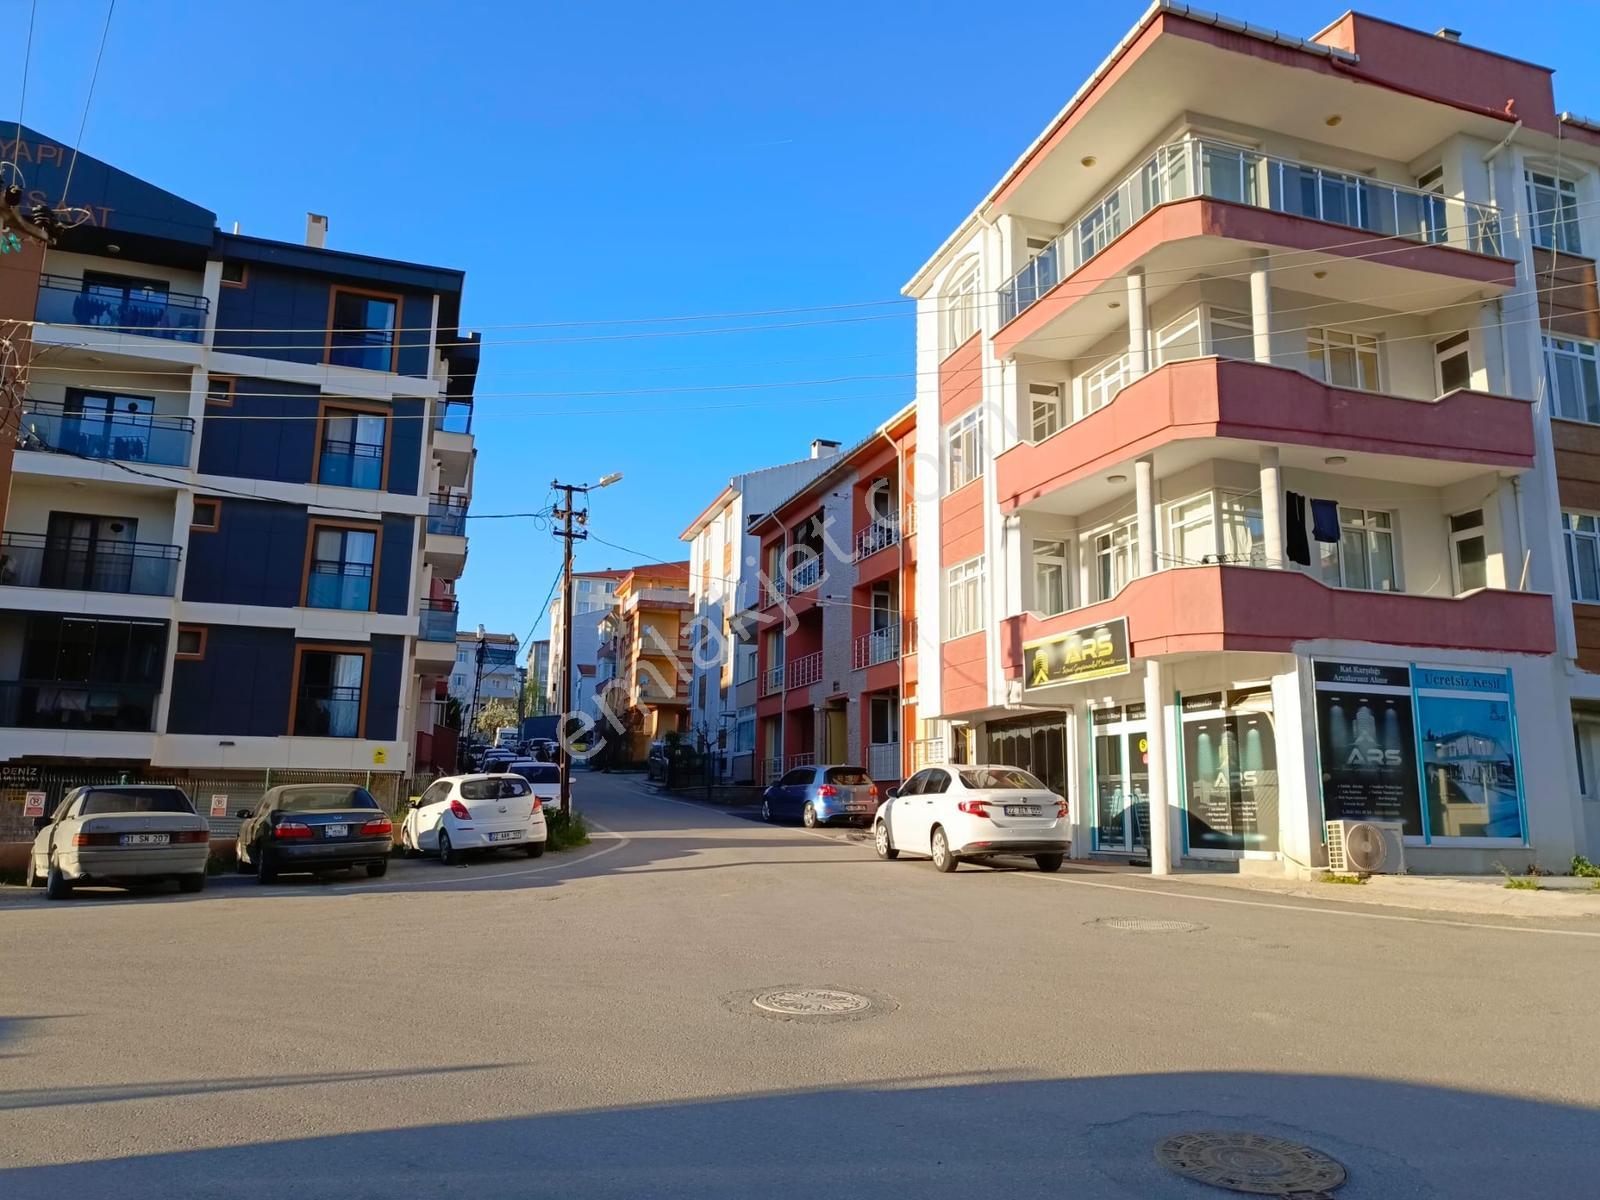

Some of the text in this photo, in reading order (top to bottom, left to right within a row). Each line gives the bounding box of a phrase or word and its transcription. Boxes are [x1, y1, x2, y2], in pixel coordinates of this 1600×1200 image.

[1064, 633, 1114, 665] ARS
[1346, 748, 1402, 766] ARS
[1213, 770, 1258, 787] ARS
